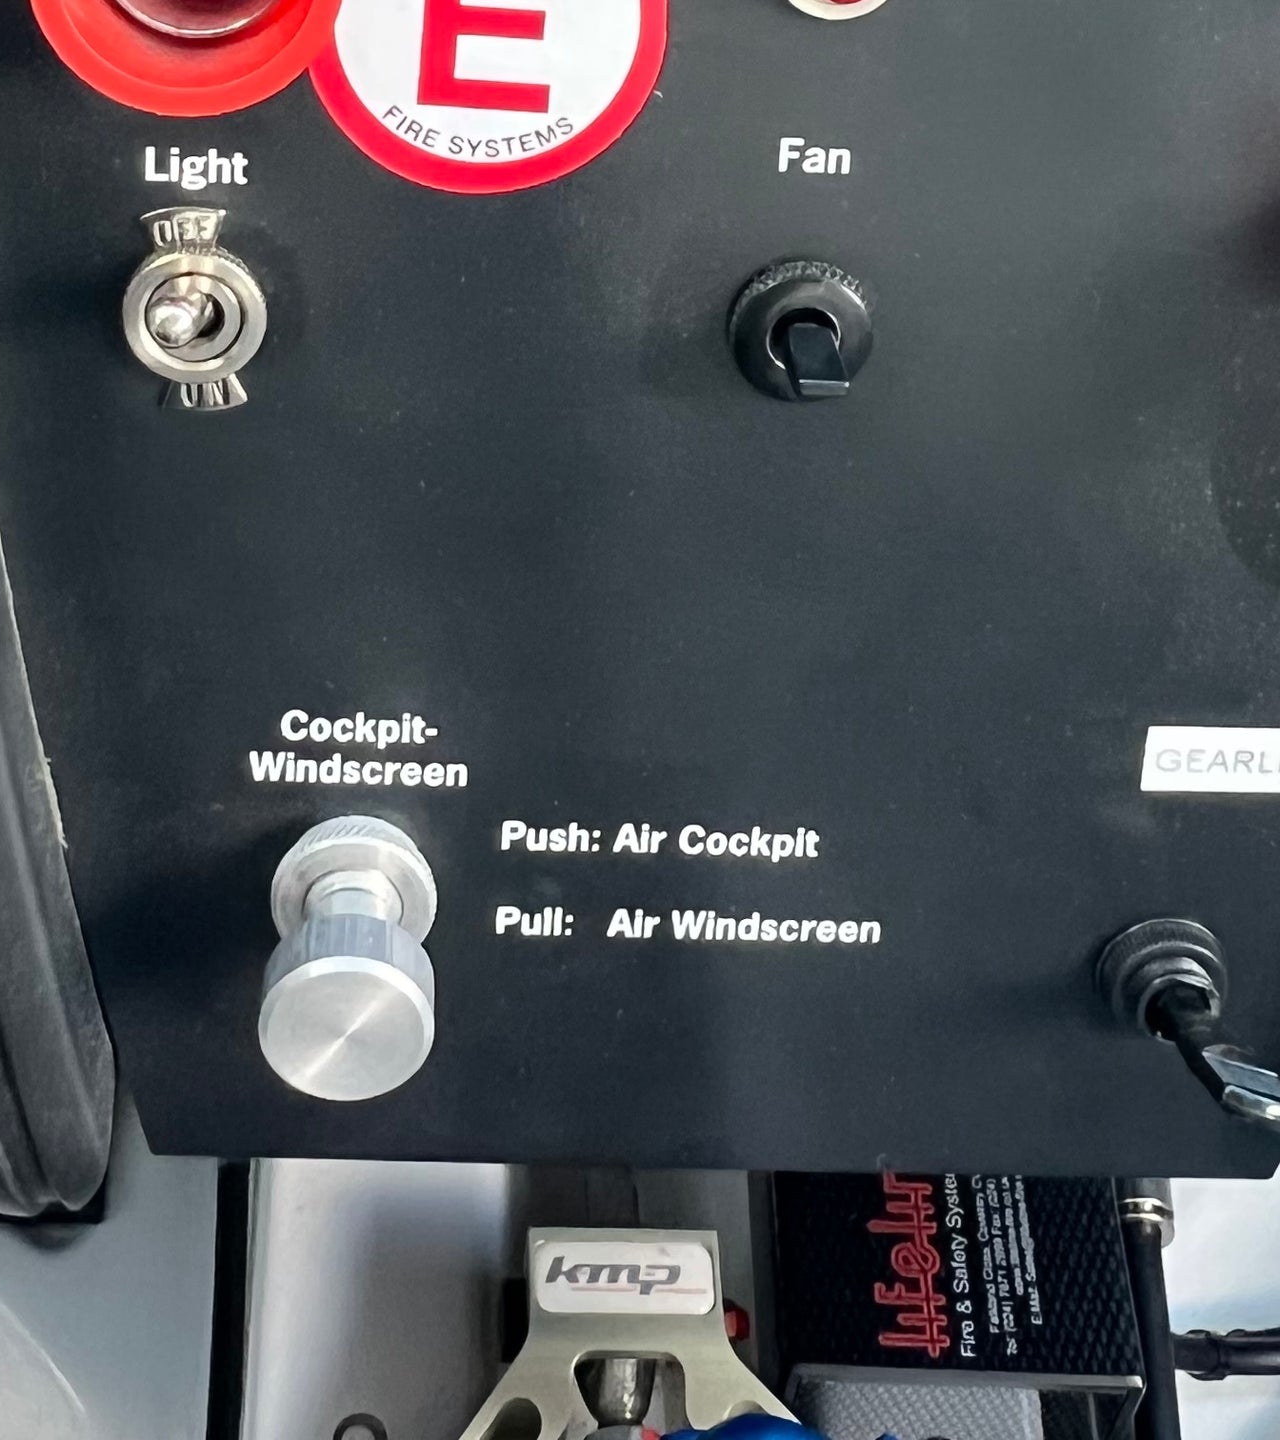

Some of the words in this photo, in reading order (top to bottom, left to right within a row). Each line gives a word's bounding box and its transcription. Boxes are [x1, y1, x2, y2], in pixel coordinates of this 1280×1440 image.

[382, 105, 441, 148] FIRE
[448, 117, 574, 158] SYSTEMS
[144, 146, 249, 191] Light
[778, 137, 851, 175] Fan
[280, 709, 438, 750] Cockpit-
[249, 750, 468, 787] Windscreen
[500, 820, 602, 852] Push:
[612, 822, 668, 854] Air
[678, 824, 820, 863] Cockpit
[495, 905, 574, 937] Pull:
[606, 908, 661, 939] Air
[671, 909, 881, 944] Windscreen
[545, 1255, 681, 1295] kmp
[955, 1299, 972, 1314] &
[960, 1320, 977, 1357] Fire
